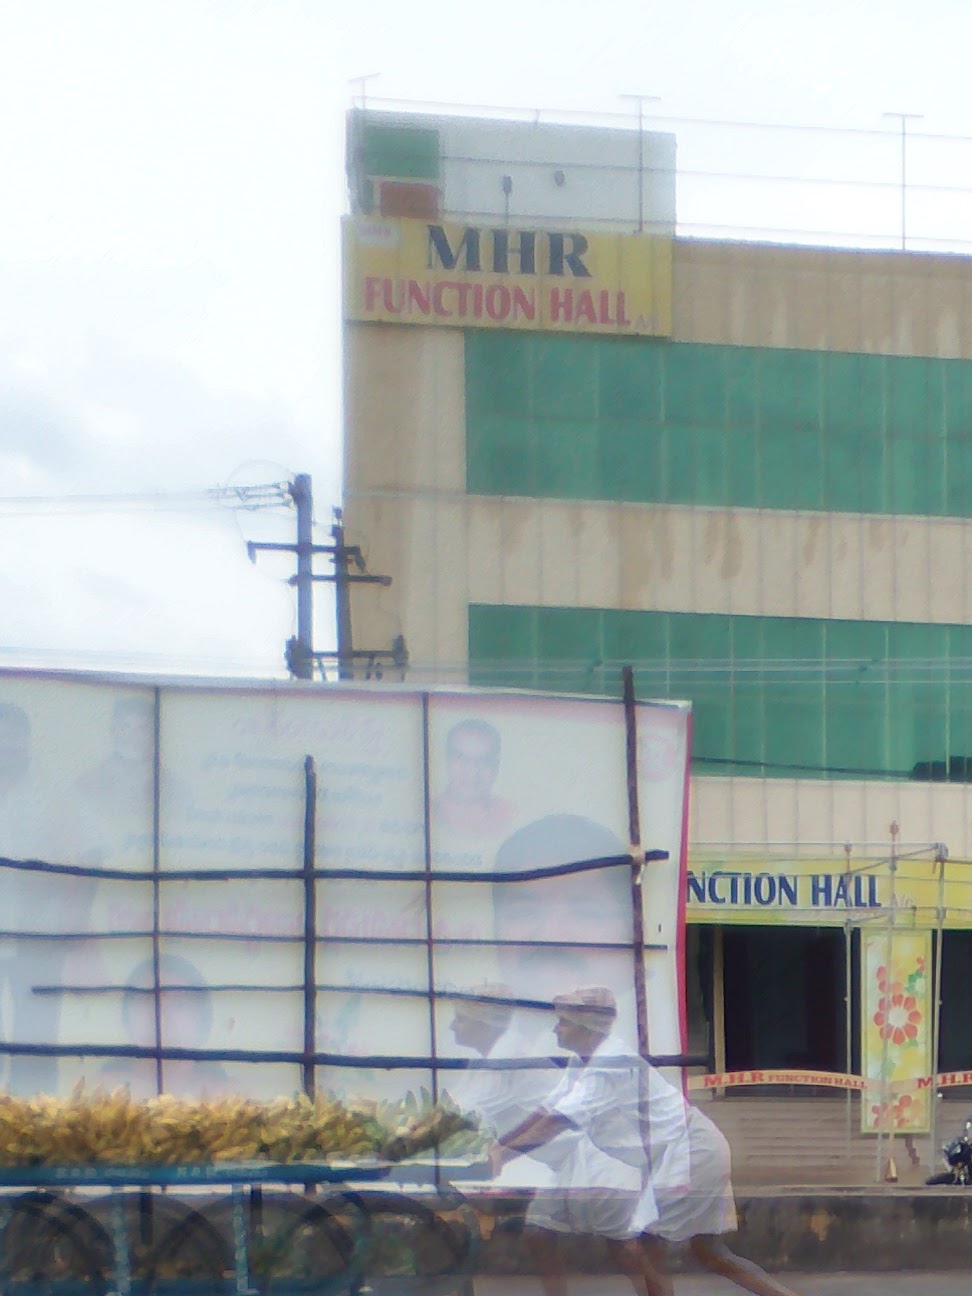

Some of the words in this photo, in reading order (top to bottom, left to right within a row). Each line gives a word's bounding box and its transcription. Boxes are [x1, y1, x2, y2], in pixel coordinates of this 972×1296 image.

[426, 223, 593, 277] MHR
[364, 276, 537, 321] FUNCTION
[550, 286, 631, 327] HALL
[811, 872, 882, 908] HALL
[768, 1073, 833, 1085] FUNCTION
[833, 1076, 868, 1090] HALL
